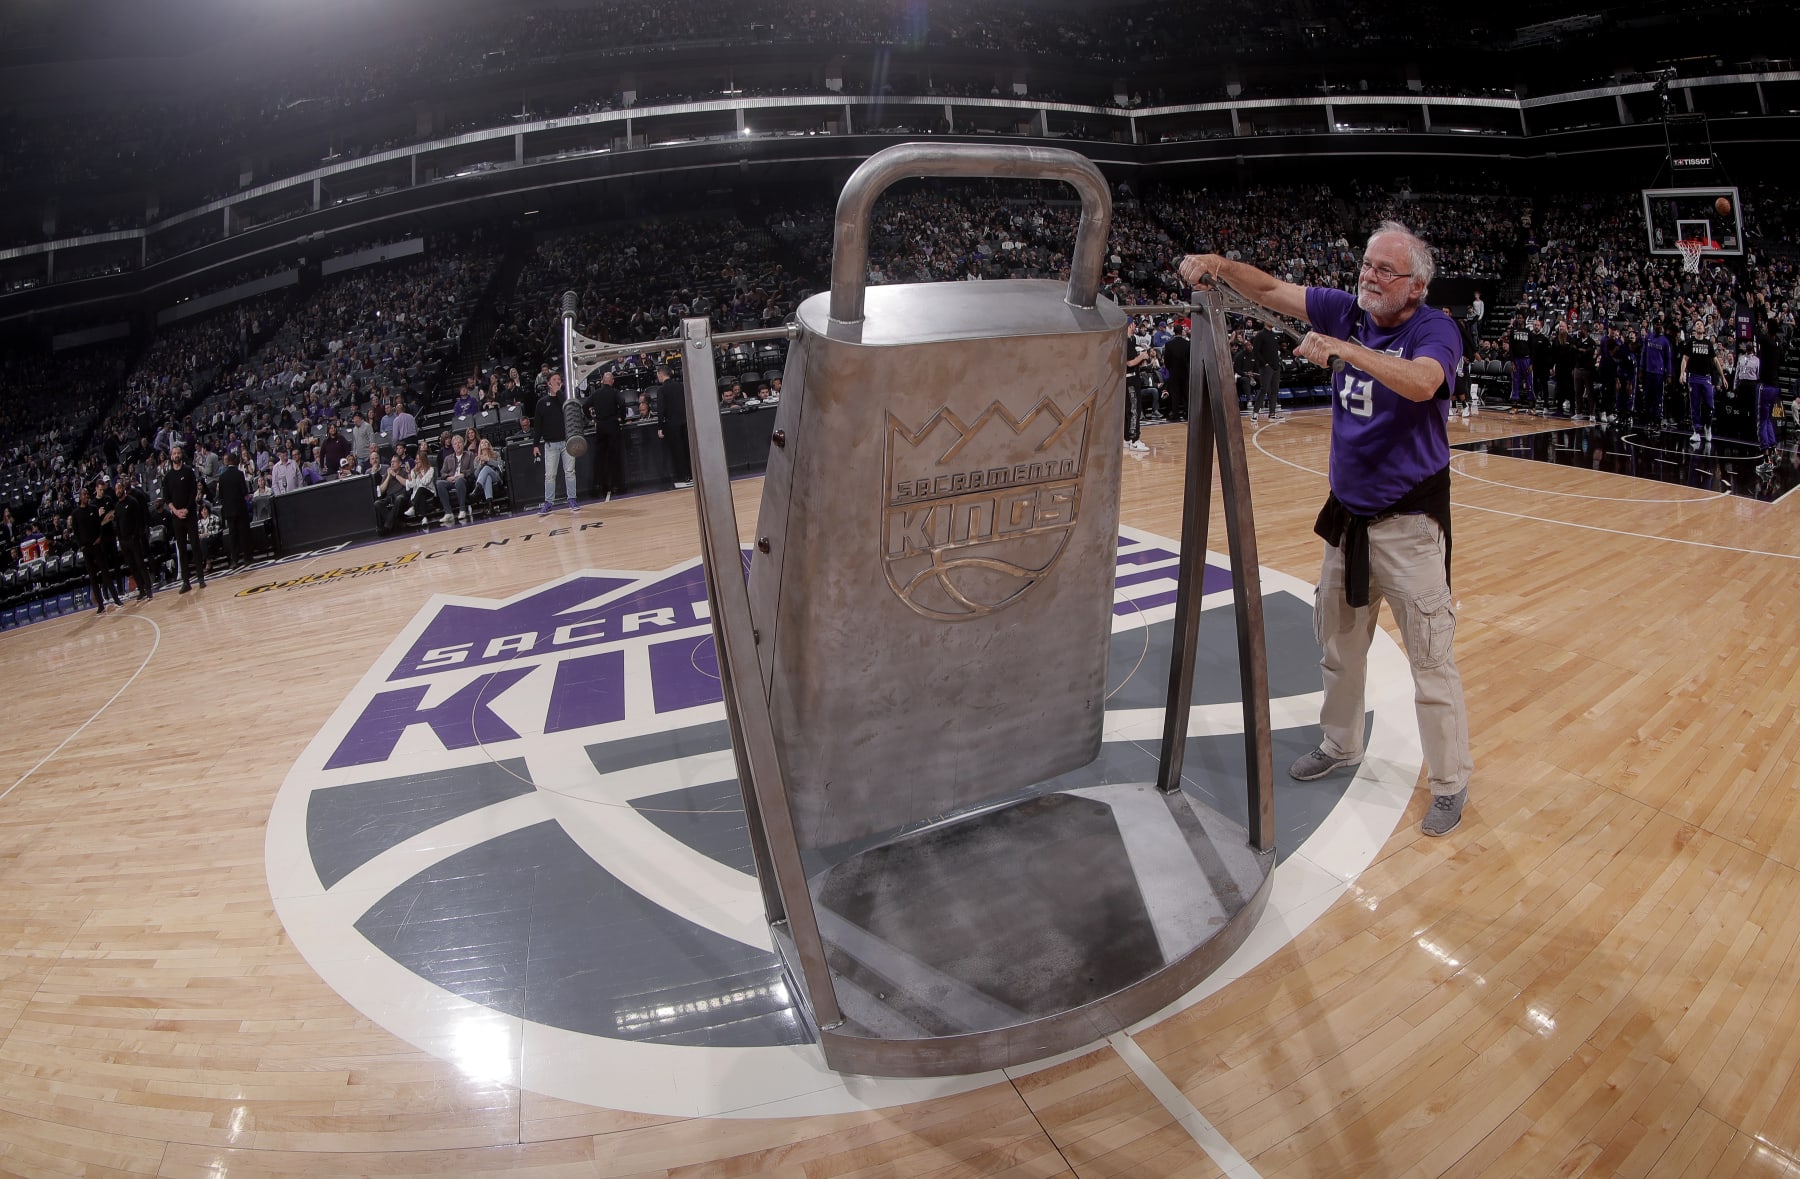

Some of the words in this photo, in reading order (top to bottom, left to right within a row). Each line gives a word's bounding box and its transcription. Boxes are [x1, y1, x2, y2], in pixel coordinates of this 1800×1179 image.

[1684, 158, 1711, 166] TISSOT
[1339, 374, 1373, 417] 13
[896, 458, 1074, 500] SACRAMENTO
[886, 484, 1079, 556] KINGS
[234, 561, 392, 597] Golden
[424, 521, 605, 560] CENTER
[286, 576, 345, 592] Credit
[351, 564, 409, 579] Union
